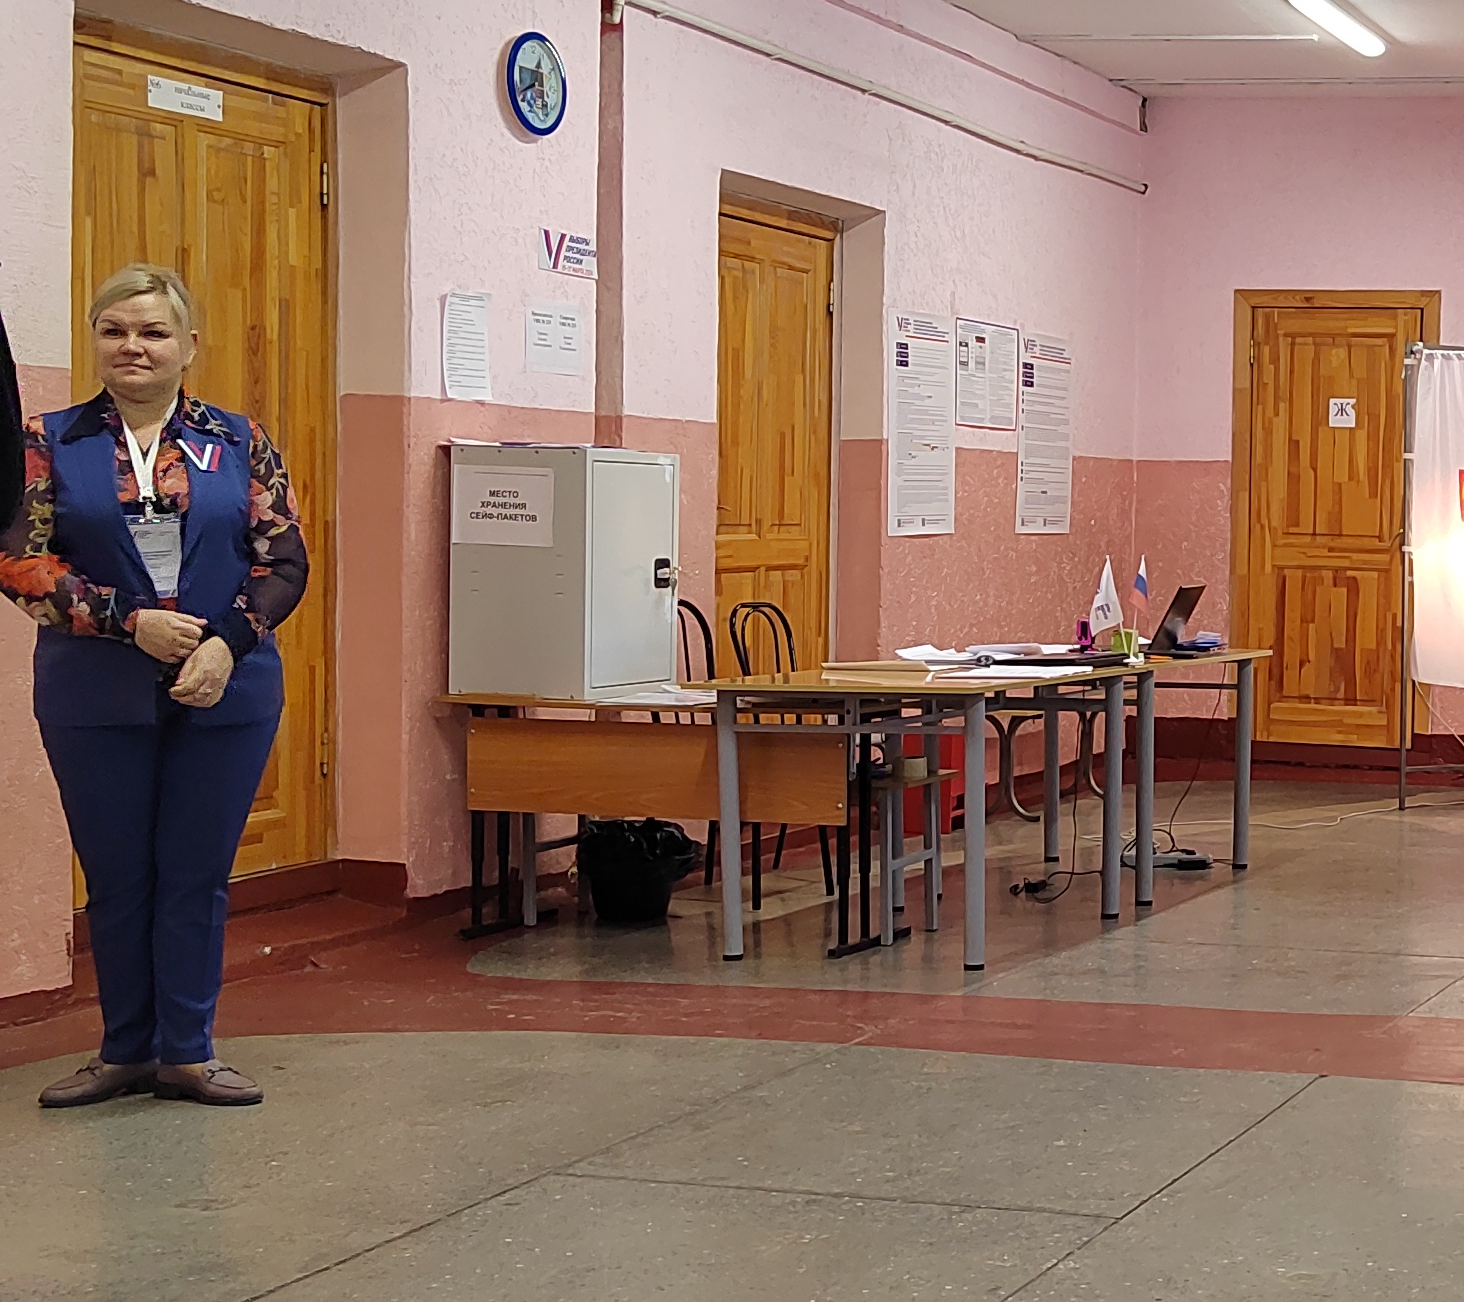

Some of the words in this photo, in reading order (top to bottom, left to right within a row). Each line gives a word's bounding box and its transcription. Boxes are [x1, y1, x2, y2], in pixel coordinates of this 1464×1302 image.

[568, 234, 592, 246] ВЫБОРЫ
[562, 255, 584, 266] РОССИИ
[1333, 402, 1351, 417] Ж
[488, 489, 520, 499] МЕСТО
[480, 500, 527, 510] ХРАНЕНИЯ
[469, 511, 538, 522] СЕЙФ-ПАКЕТОВ
